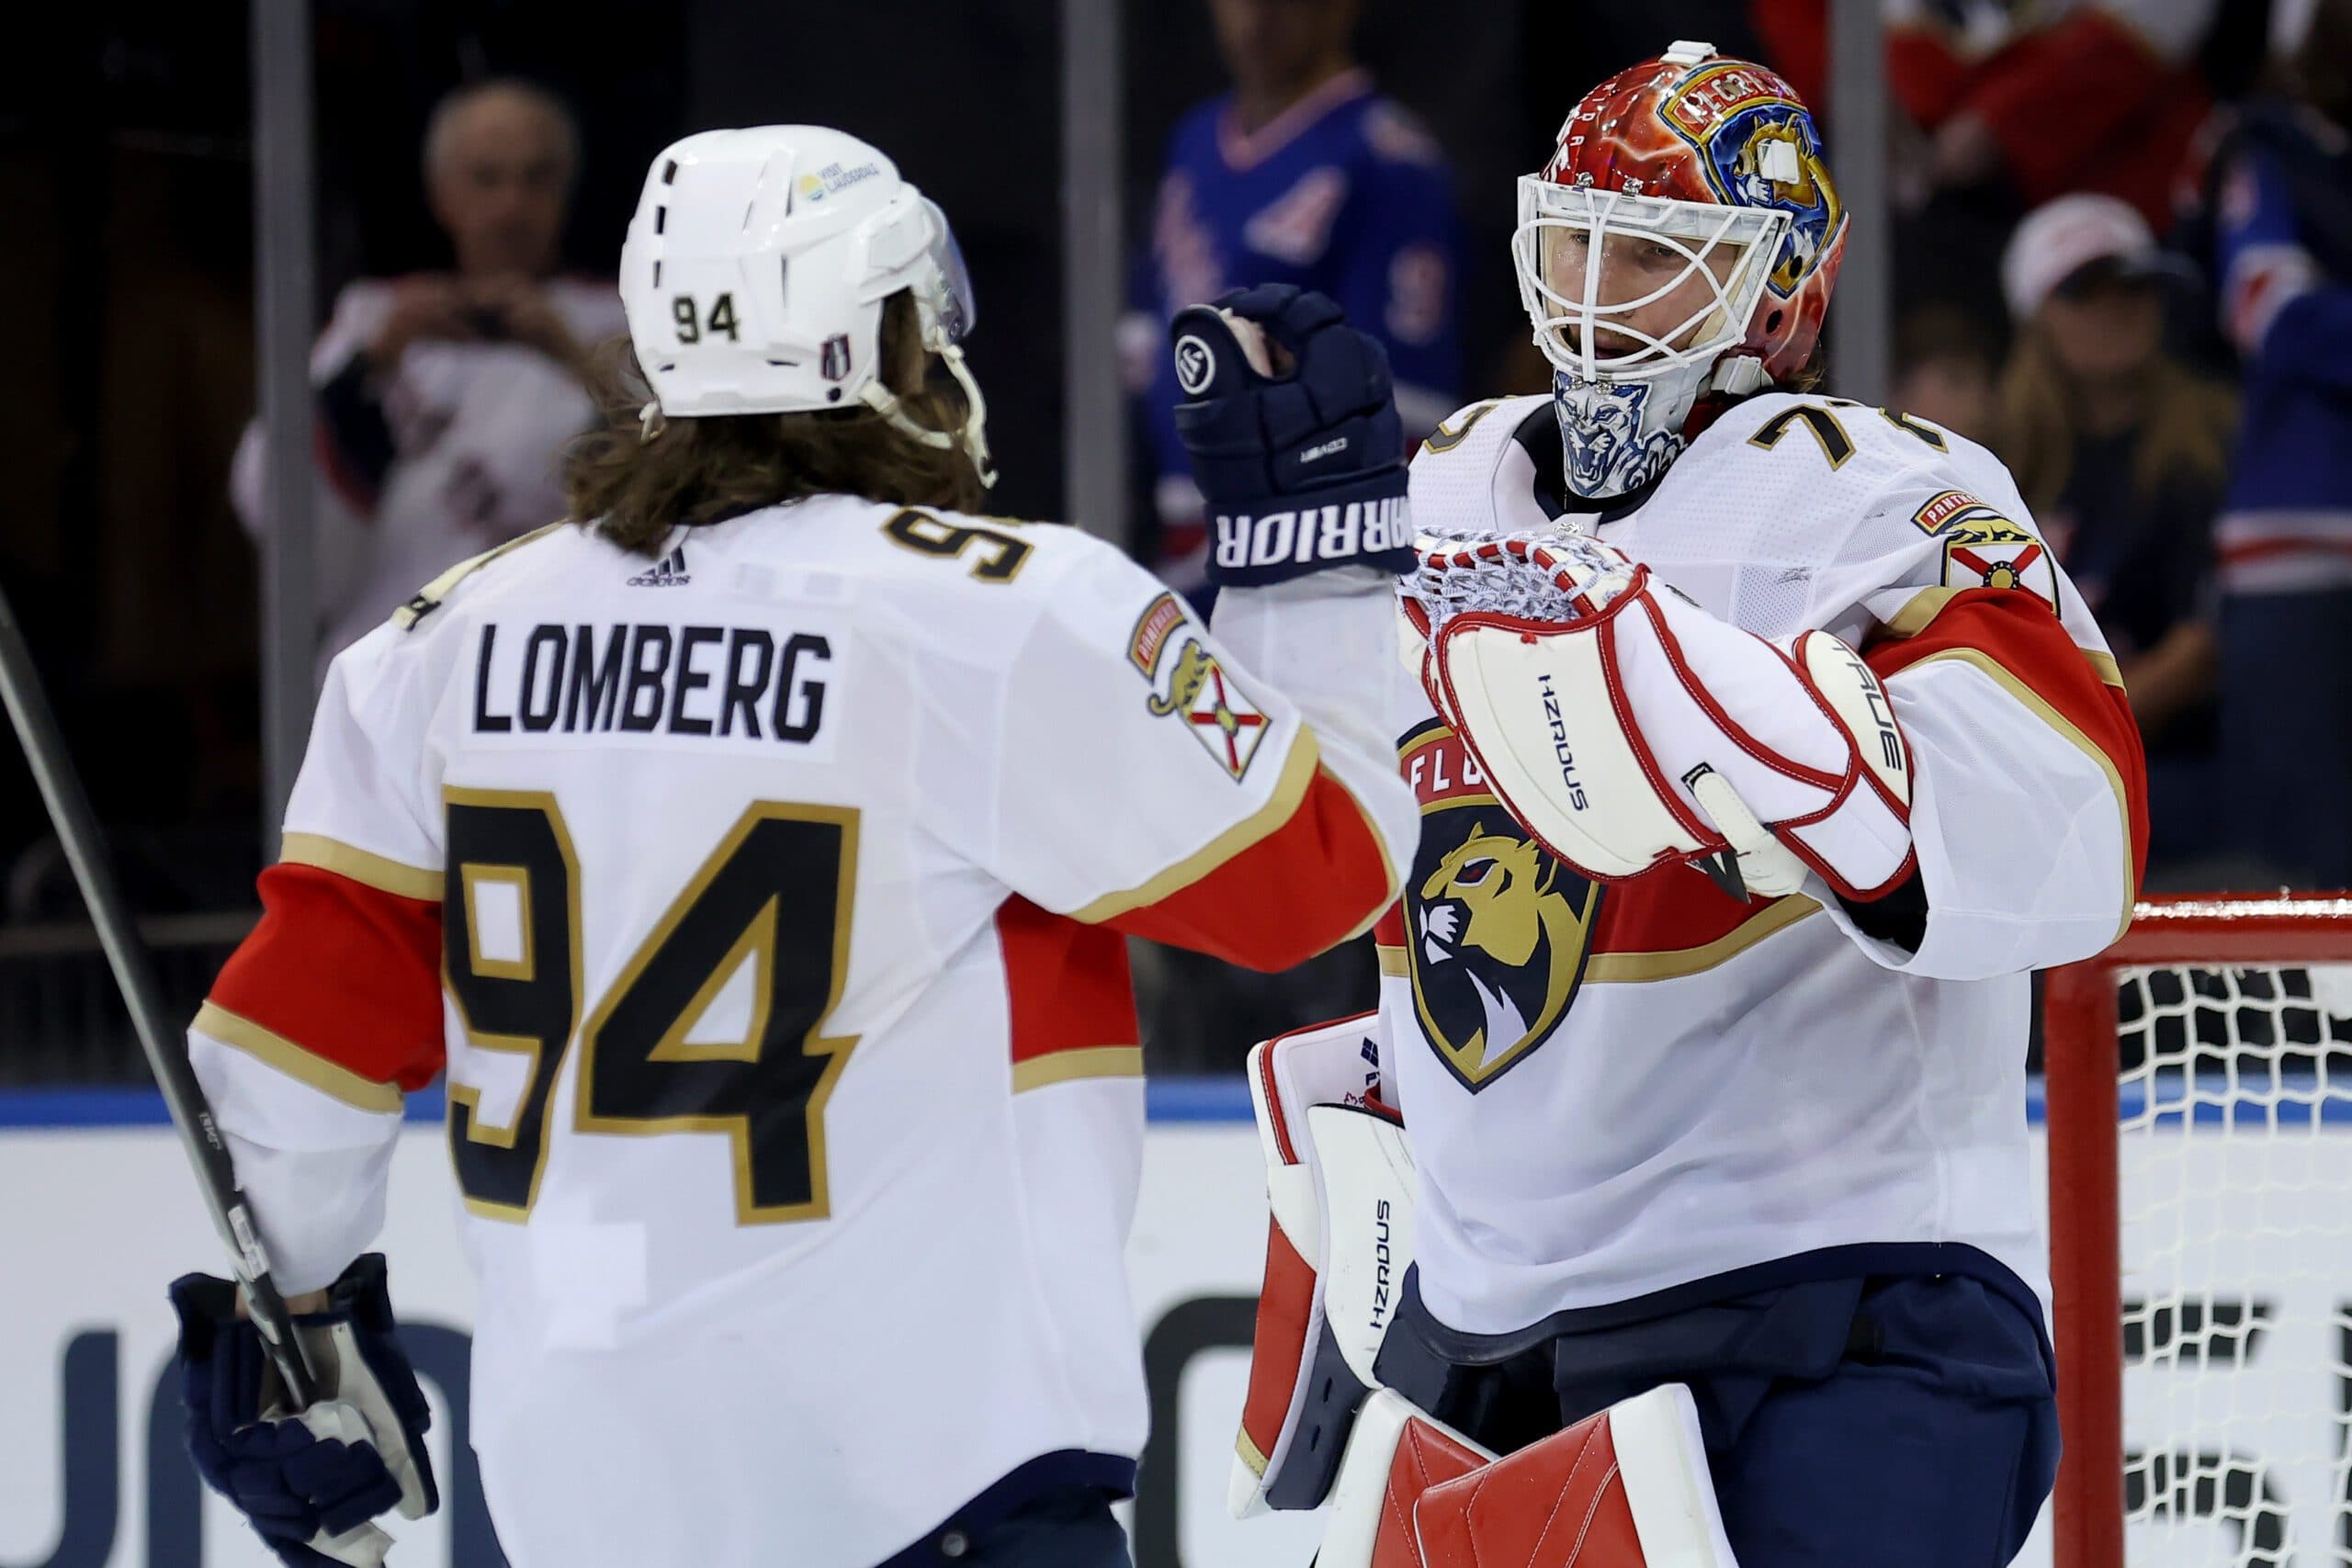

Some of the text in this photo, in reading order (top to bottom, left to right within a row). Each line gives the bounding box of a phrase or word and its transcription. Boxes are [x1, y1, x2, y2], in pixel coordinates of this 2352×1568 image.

[672, 292, 740, 345] 94
[474, 624, 832, 744] LOMBERG
[1536, 674, 1589, 811] HZRDUS
[1831, 642, 1903, 772] TRUE
[443, 784, 863, 1226] 94
[1369, 1199, 1390, 1328] HZRDUS
